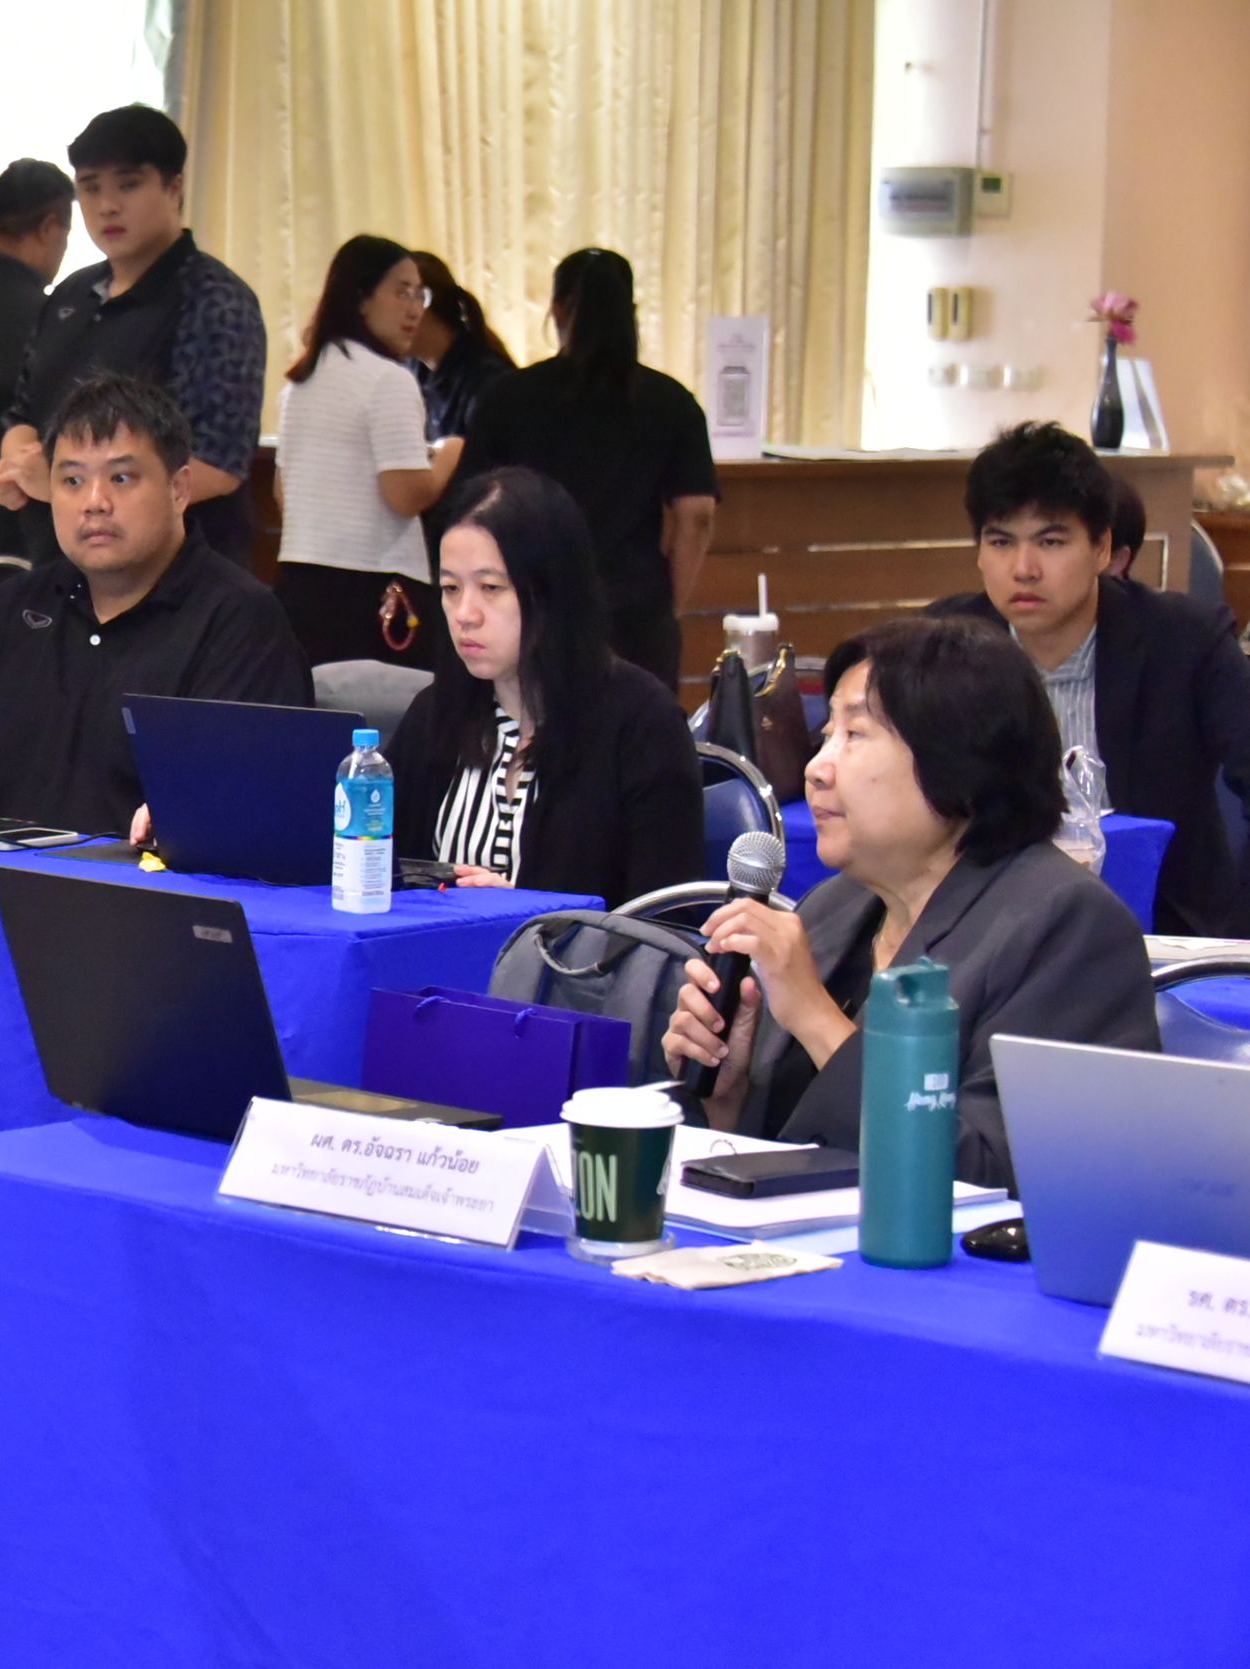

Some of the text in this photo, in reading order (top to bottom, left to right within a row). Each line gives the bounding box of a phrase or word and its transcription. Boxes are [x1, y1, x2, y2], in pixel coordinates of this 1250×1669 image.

[311, 1133, 335, 1151] ผศ.
[416, 1145, 480, 1174] แก้วน้อย
[572, 1150, 617, 1222] ON
